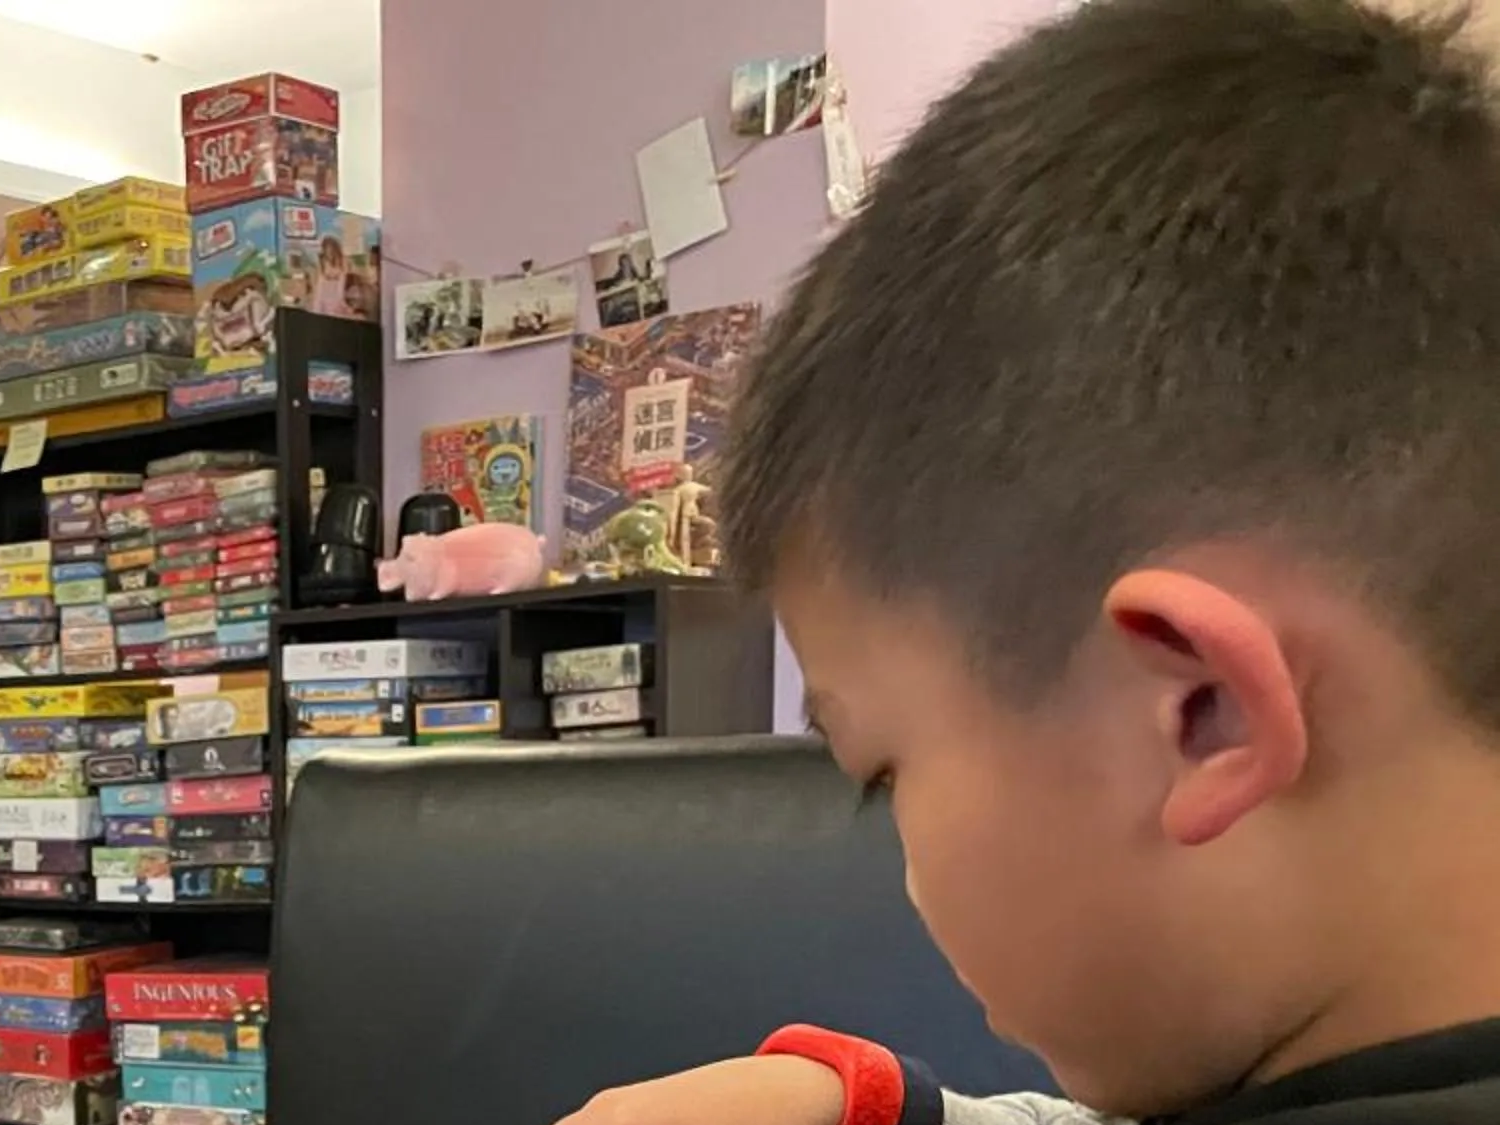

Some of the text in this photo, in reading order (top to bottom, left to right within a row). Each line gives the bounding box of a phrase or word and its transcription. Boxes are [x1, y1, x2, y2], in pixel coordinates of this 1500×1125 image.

[202, 130, 247, 161] GIFT
[197, 151, 254, 184] TRAP
[133, 982, 238, 1003] INGENIOUS
